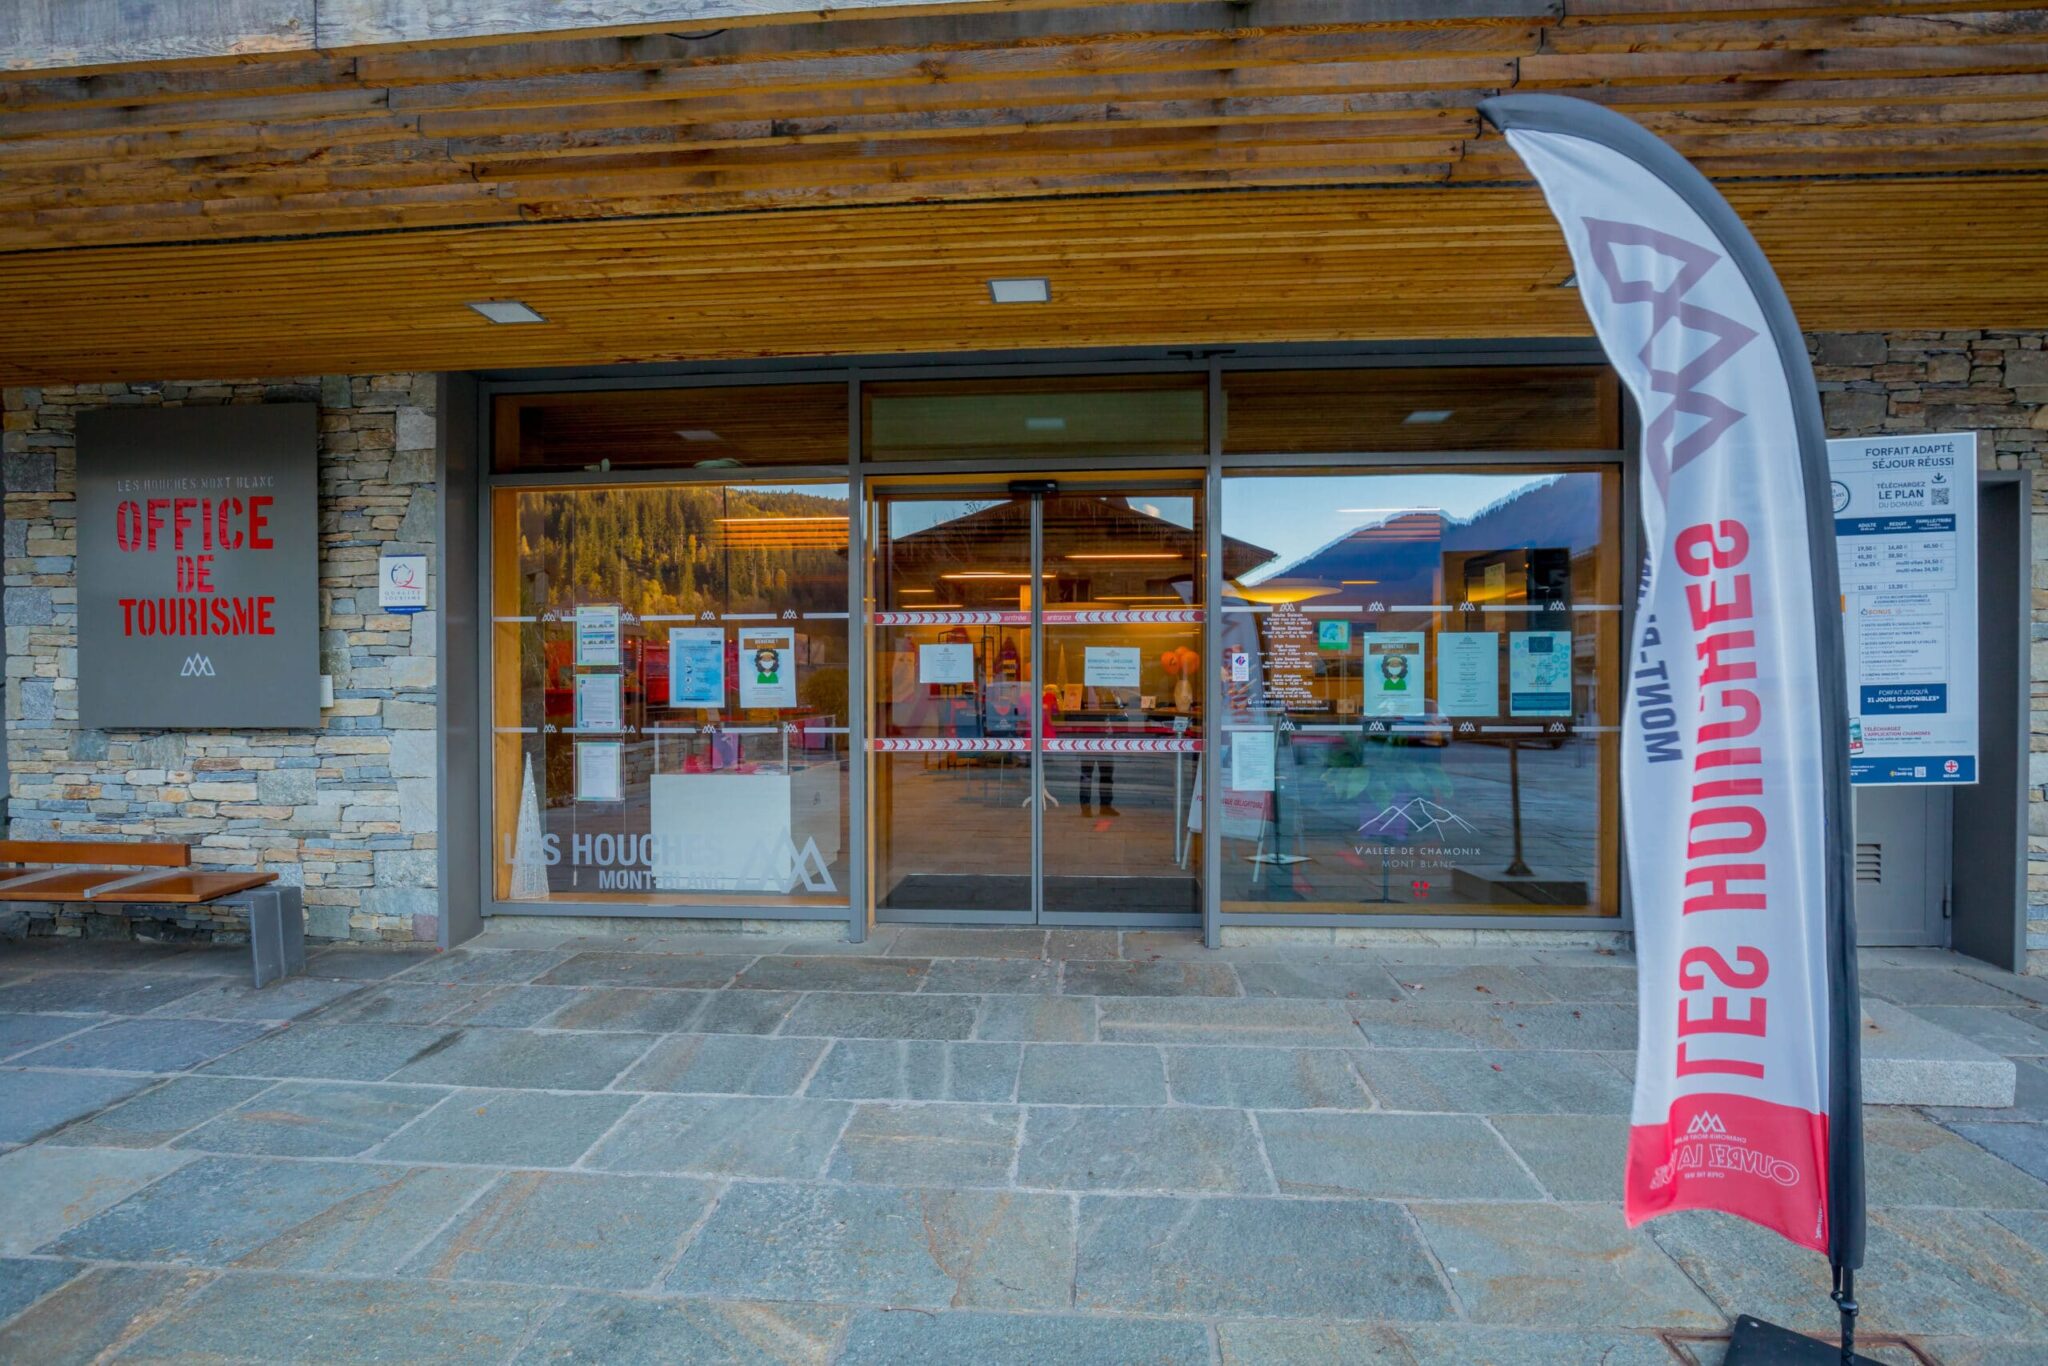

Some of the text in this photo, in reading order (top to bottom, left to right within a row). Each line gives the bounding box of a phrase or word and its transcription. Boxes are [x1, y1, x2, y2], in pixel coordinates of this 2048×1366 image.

[1866, 442, 1954, 457] FORFAIT ADAPTÉ
[1872, 455, 1954, 470] SÉJOUR RÉUSSI
[117, 475, 274, 492] LES HOUCHES MONT BLANC
[1877, 480, 1926, 490] TÉLÉCHARGEZ
[1879, 489, 1924, 500] LE PLAN
[1879, 499, 1924, 509] DU DOMAINE
[117, 496, 273, 552] OFFICE
[177, 554, 214, 593] DE
[118, 596, 275, 637] TOURISME
[1878, 689, 1903, 697] FORFAIT
[1401, 846, 1415, 856] DE
[1420, 846, 1481, 857] CHAMONIX
[1382, 859, 1457, 869] MONT BLANC
